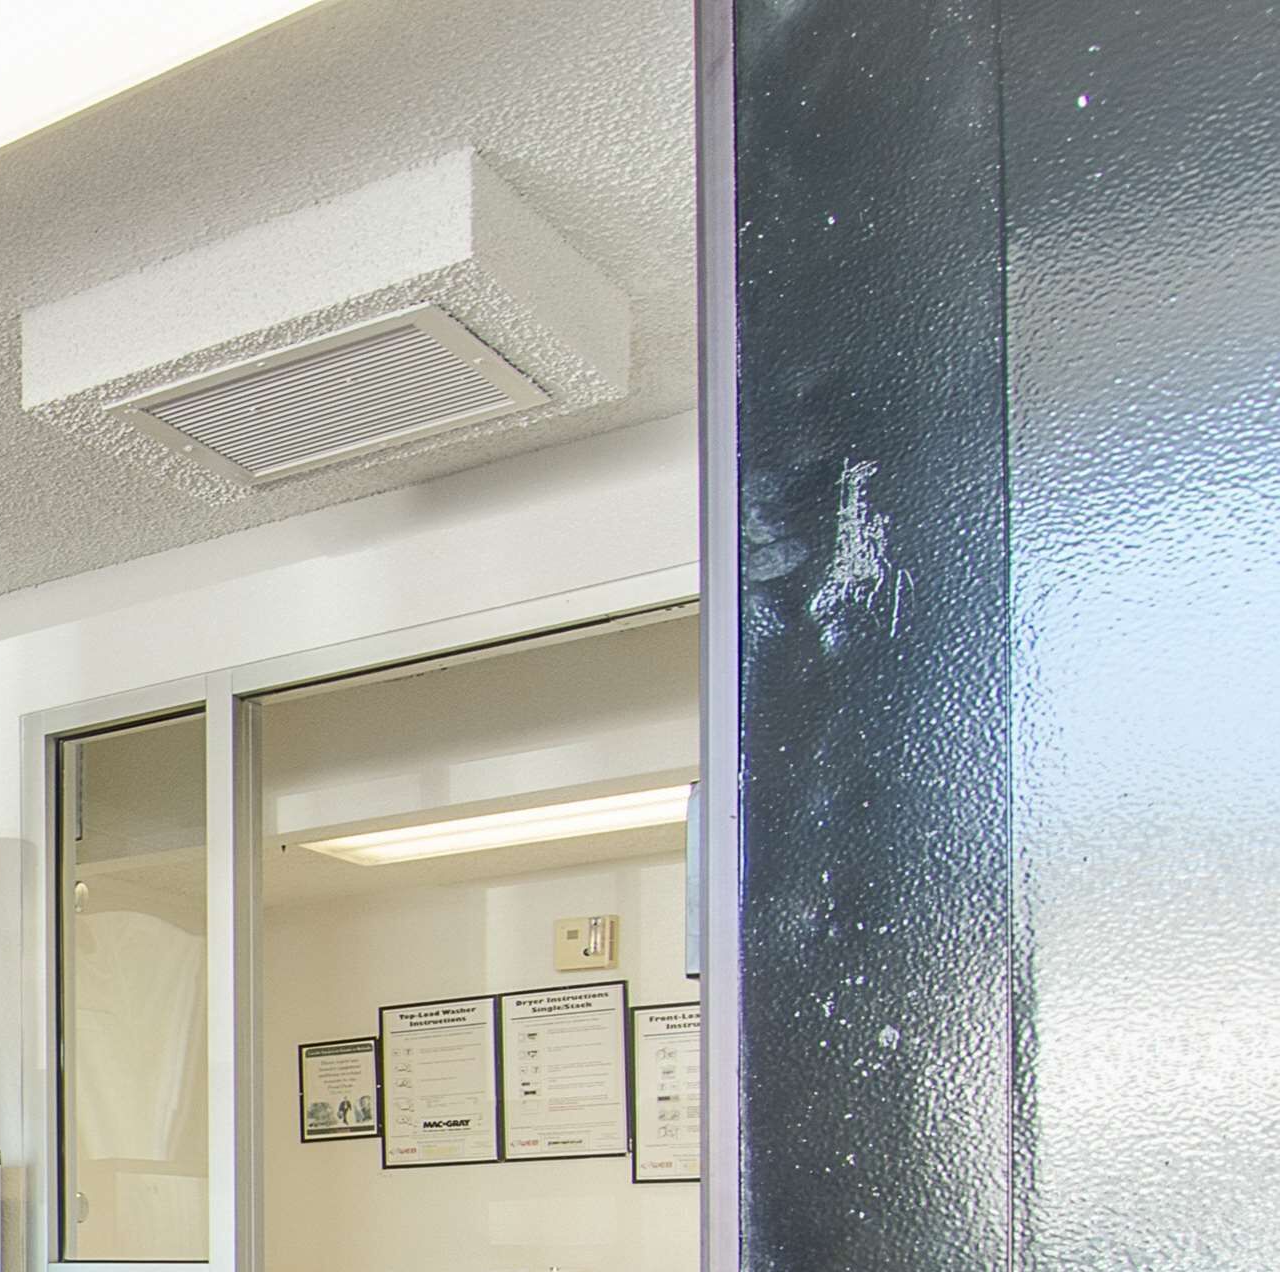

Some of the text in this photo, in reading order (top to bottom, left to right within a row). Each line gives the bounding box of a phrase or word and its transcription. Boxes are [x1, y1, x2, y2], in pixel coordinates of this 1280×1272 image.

[516, 992, 609, 1007] Dryer Instructions
[399, 1007, 477, 1020] Top-Load Washer
[409, 1016, 467, 1027] Instructions
